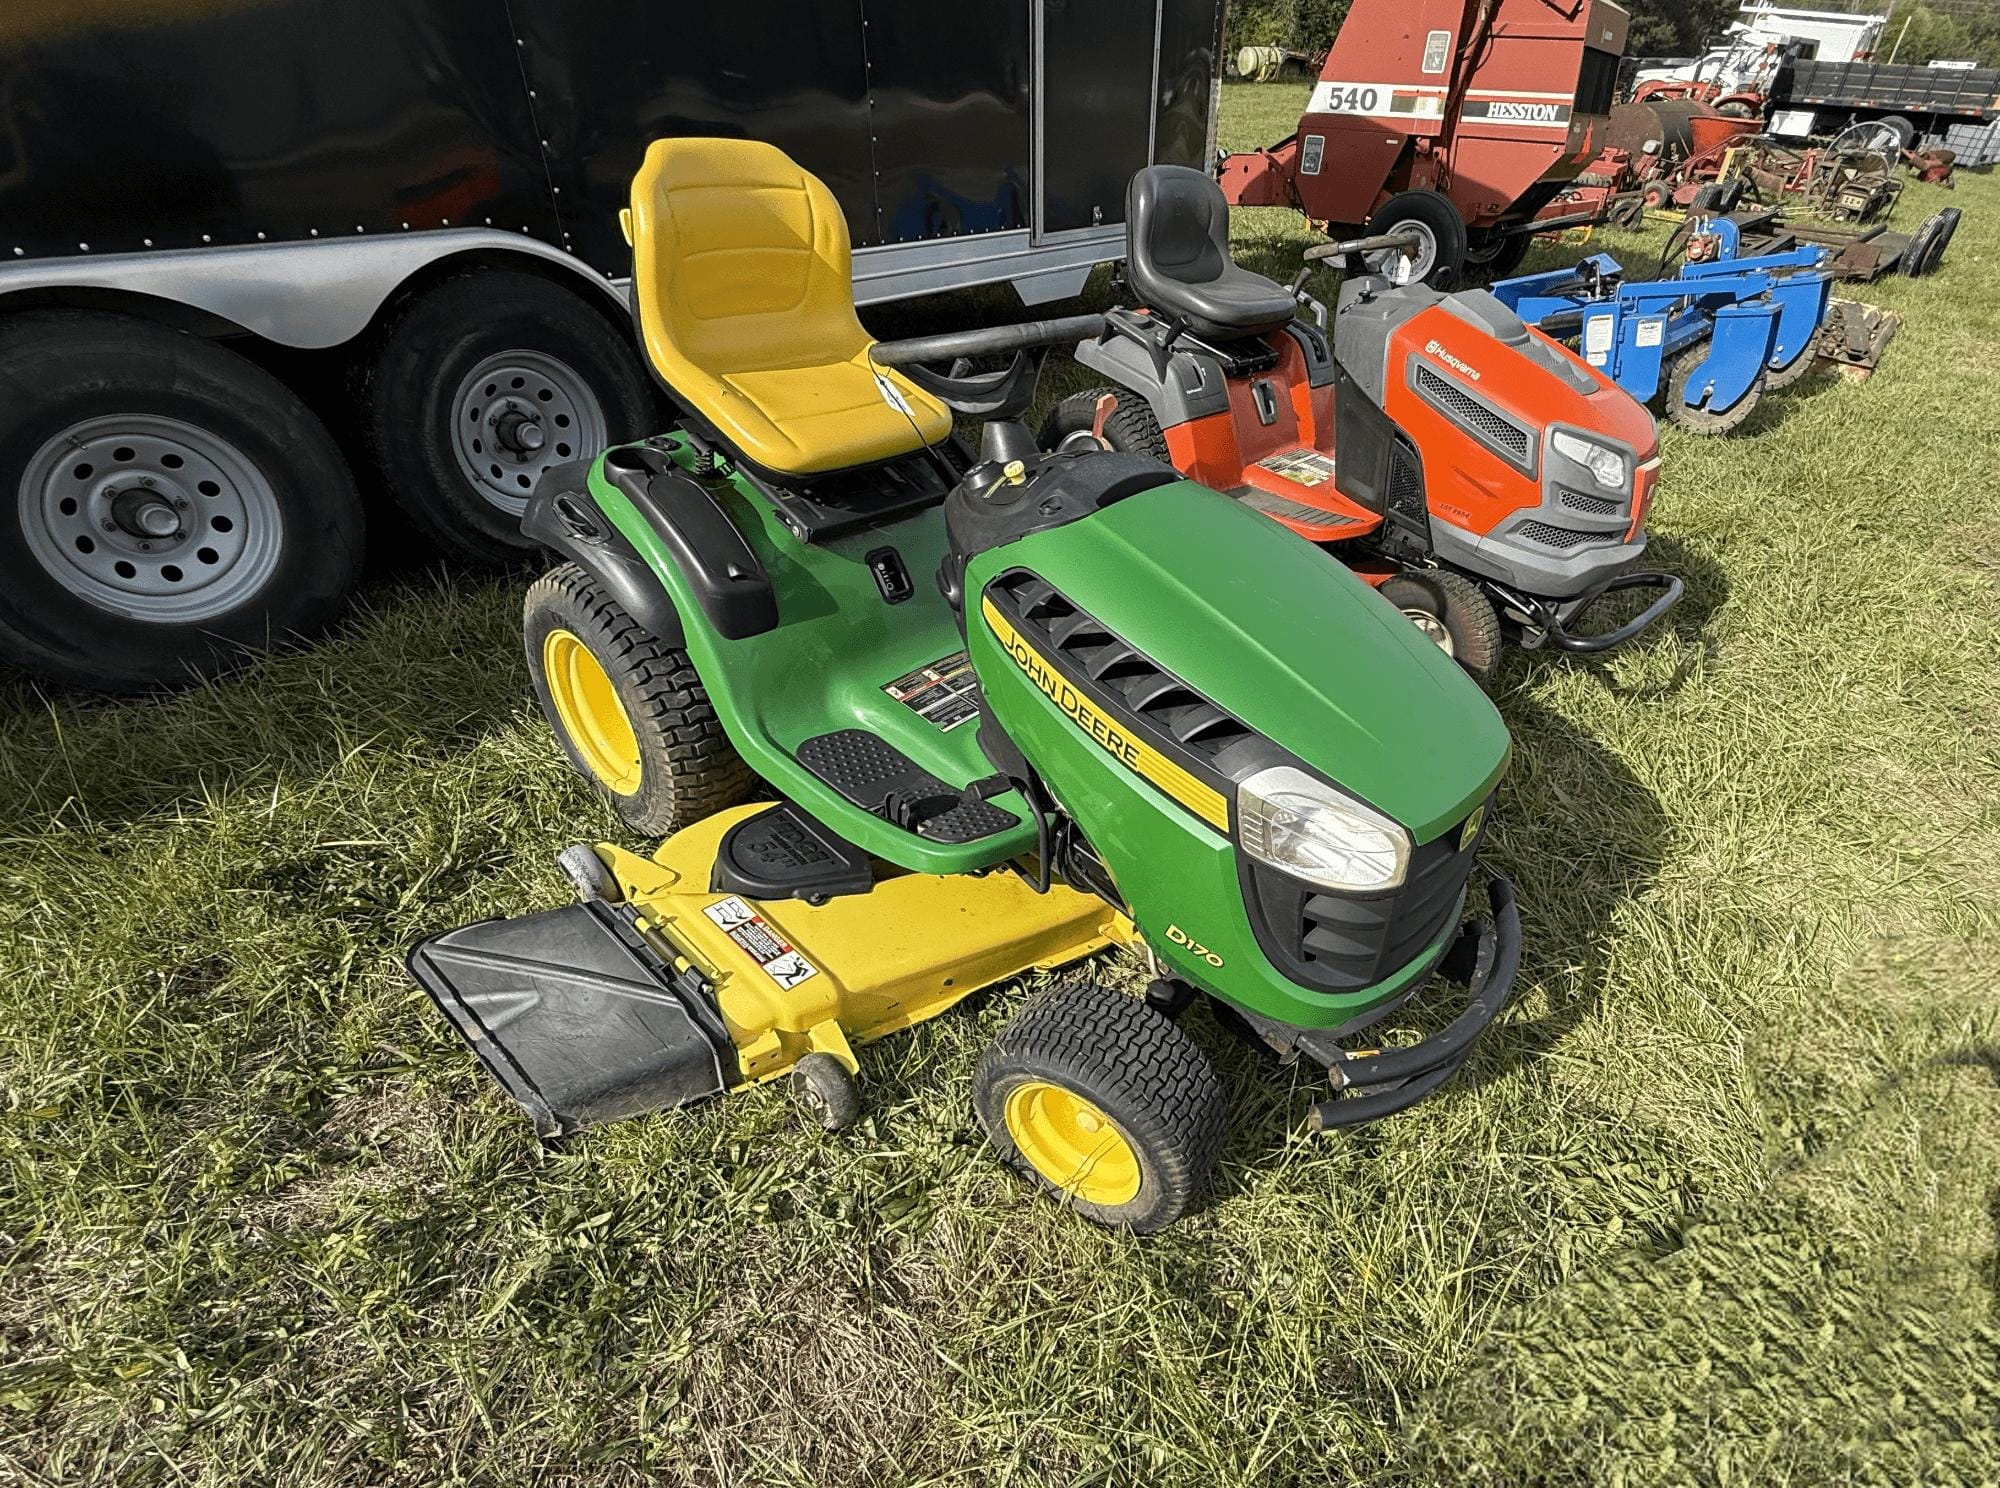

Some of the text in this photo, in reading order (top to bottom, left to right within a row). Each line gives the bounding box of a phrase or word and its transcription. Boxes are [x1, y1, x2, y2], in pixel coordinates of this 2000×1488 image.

[1328, 87, 1378, 112] 540
[1486, 102, 1558, 121] HESSTON
[1435, 348, 1481, 380] Husqvarna
[1004, 631, 1057, 698] JOHN
[1060, 685, 1141, 769] DEERE
[1164, 924, 1224, 967] D170
